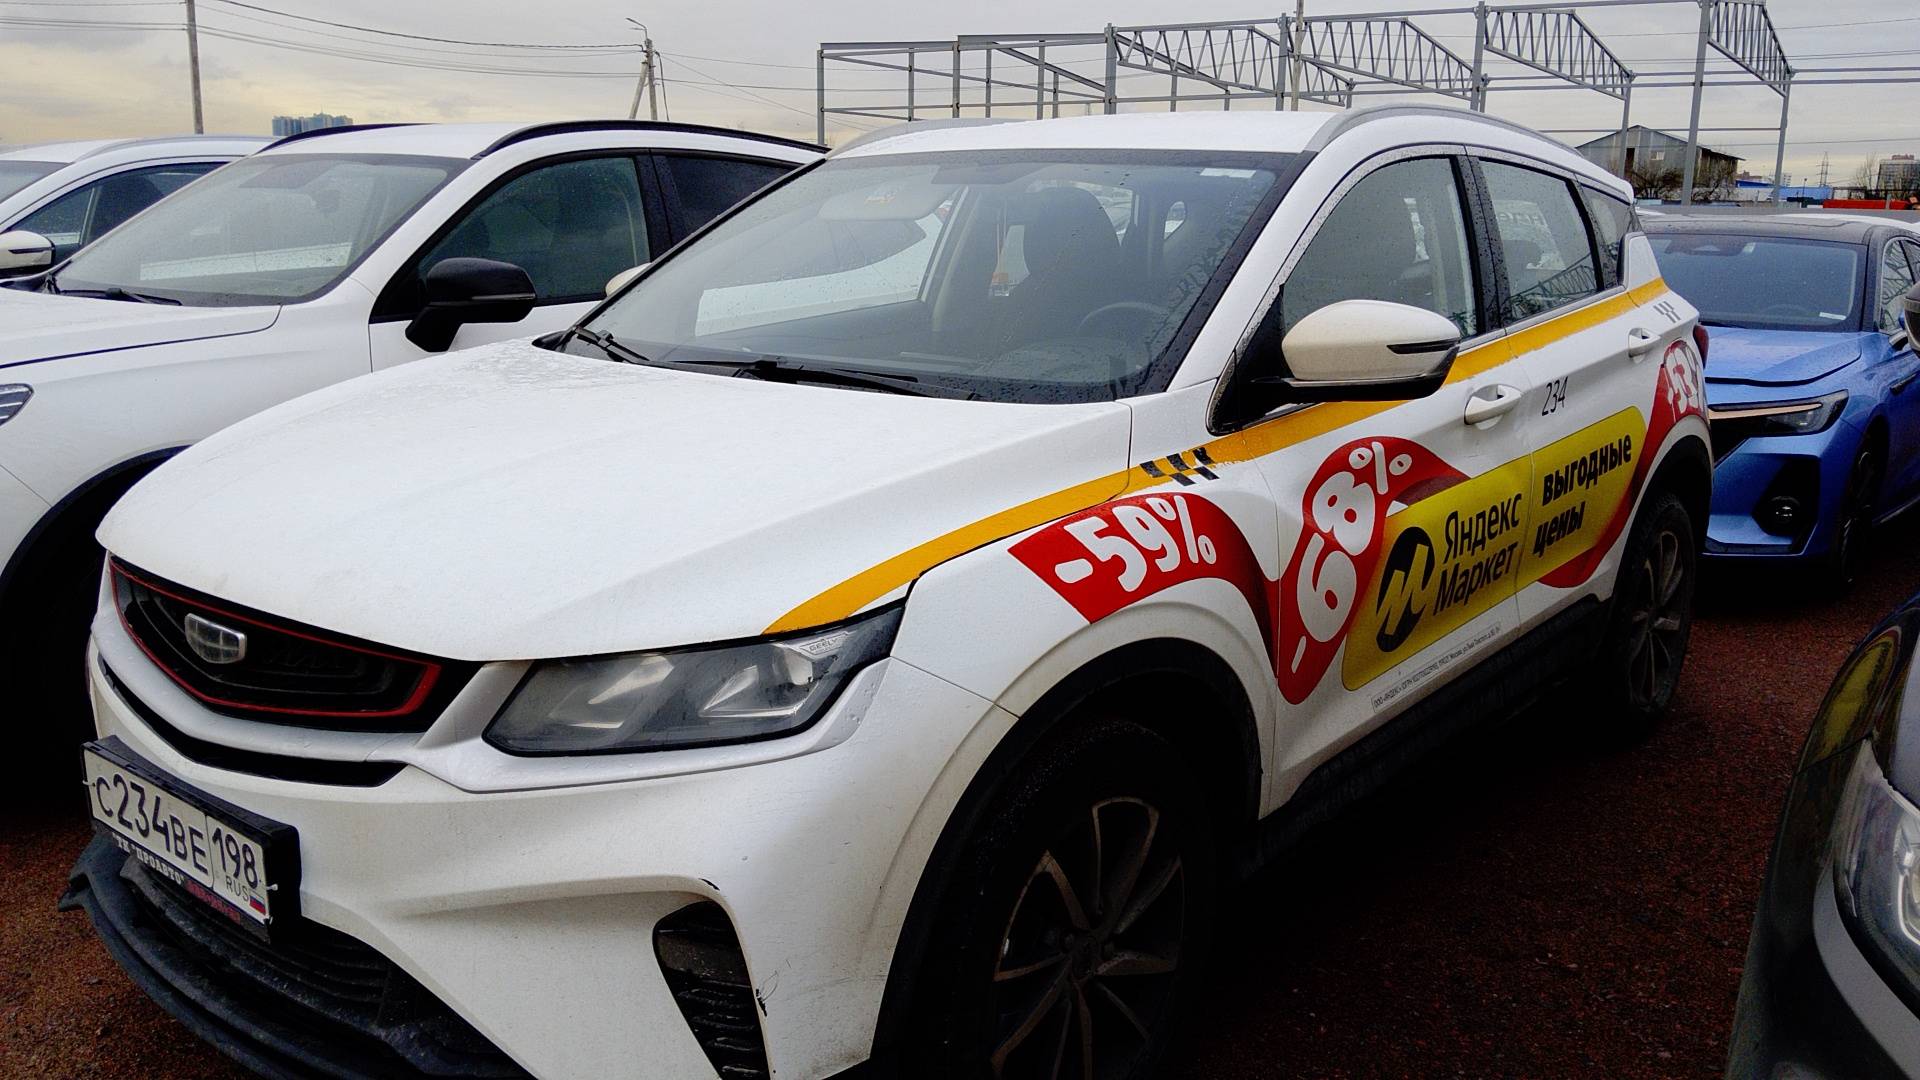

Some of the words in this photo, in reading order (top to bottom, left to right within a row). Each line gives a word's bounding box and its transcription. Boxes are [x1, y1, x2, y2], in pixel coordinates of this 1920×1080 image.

[1541, 375, 1568, 416] 234
[1541, 434, 1632, 507] выгодные
[1054, 494, 1217, 593] -59%
[1290, 441, 1413, 673] -68%
[1442, 493, 1522, 564] Яндекс
[1532, 501, 1586, 558] цены
[1433, 541, 1519, 617] Маркет
[212, 827, 259, 890] 198
[225, 874, 251, 902] RUS
